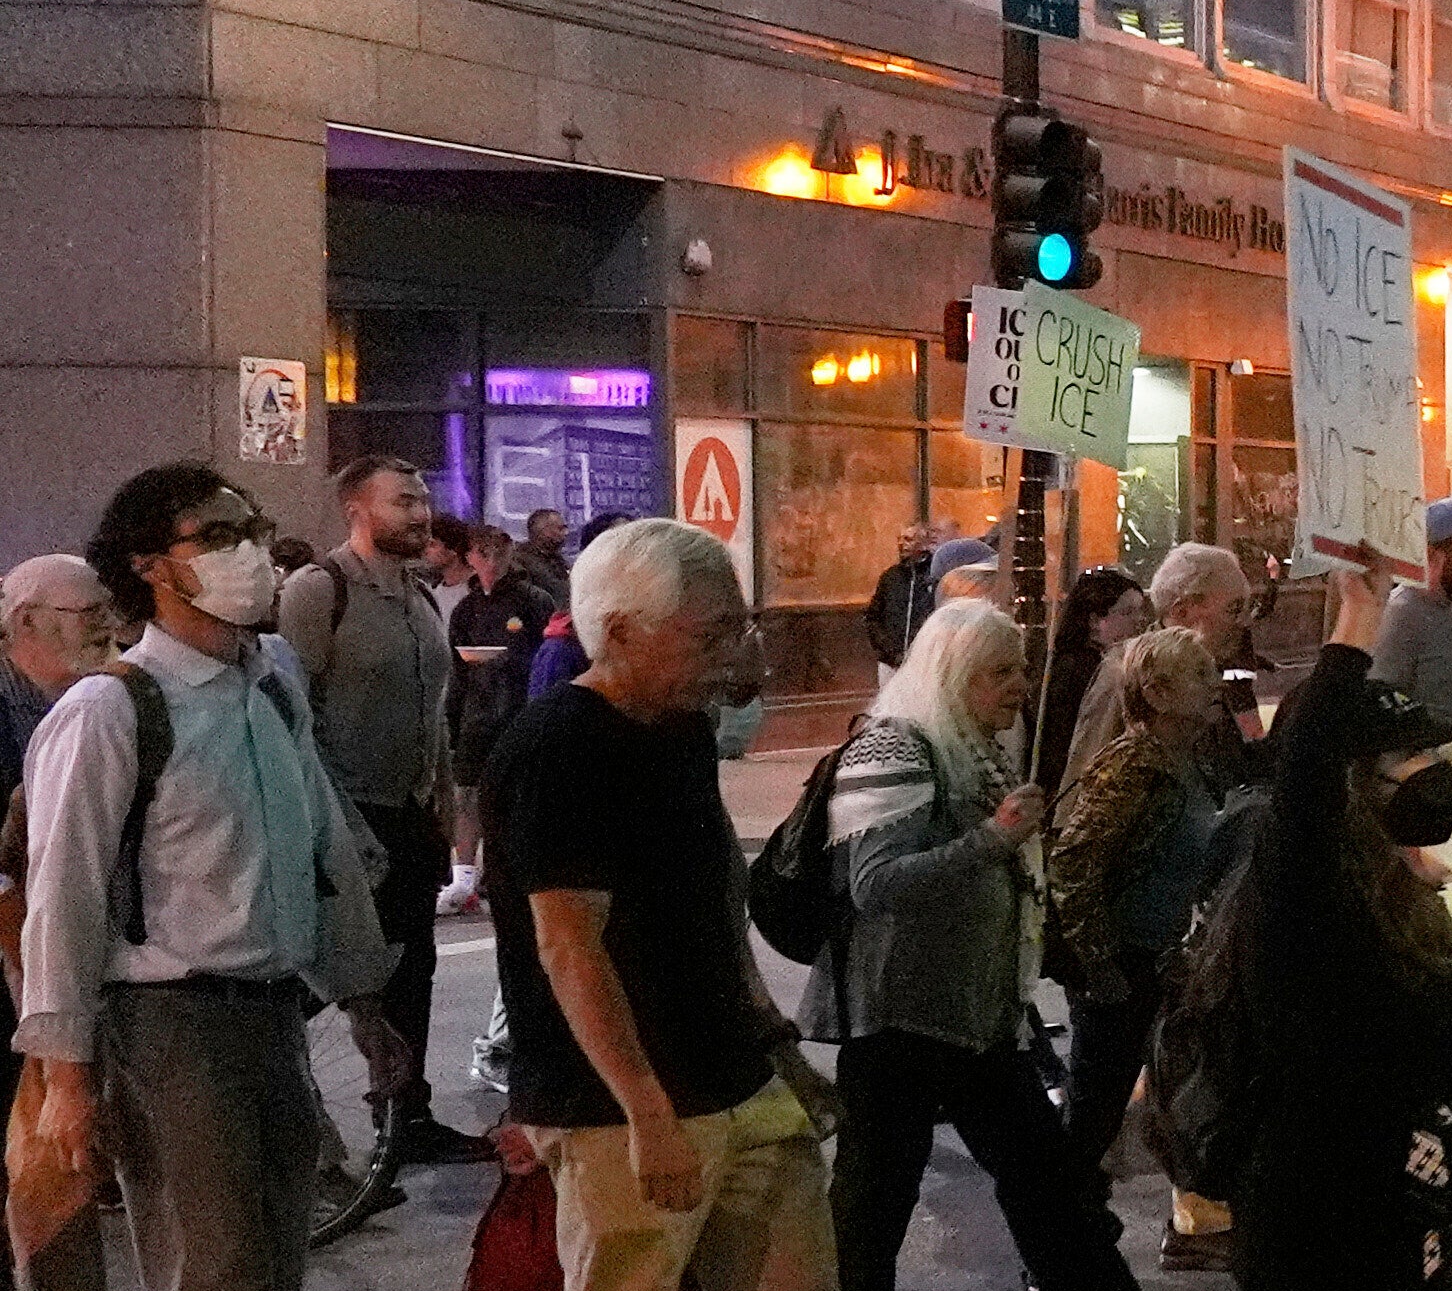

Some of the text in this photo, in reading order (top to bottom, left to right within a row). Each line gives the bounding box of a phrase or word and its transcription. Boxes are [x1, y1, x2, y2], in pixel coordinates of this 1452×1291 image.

[1165, 186, 1245, 257] Family
[1354, 216, 1402, 326] ICE
[999, 307, 1026, 336] IC
[1036, 309, 1125, 394] CRUSH
[1049, 375, 1101, 439] ICE
